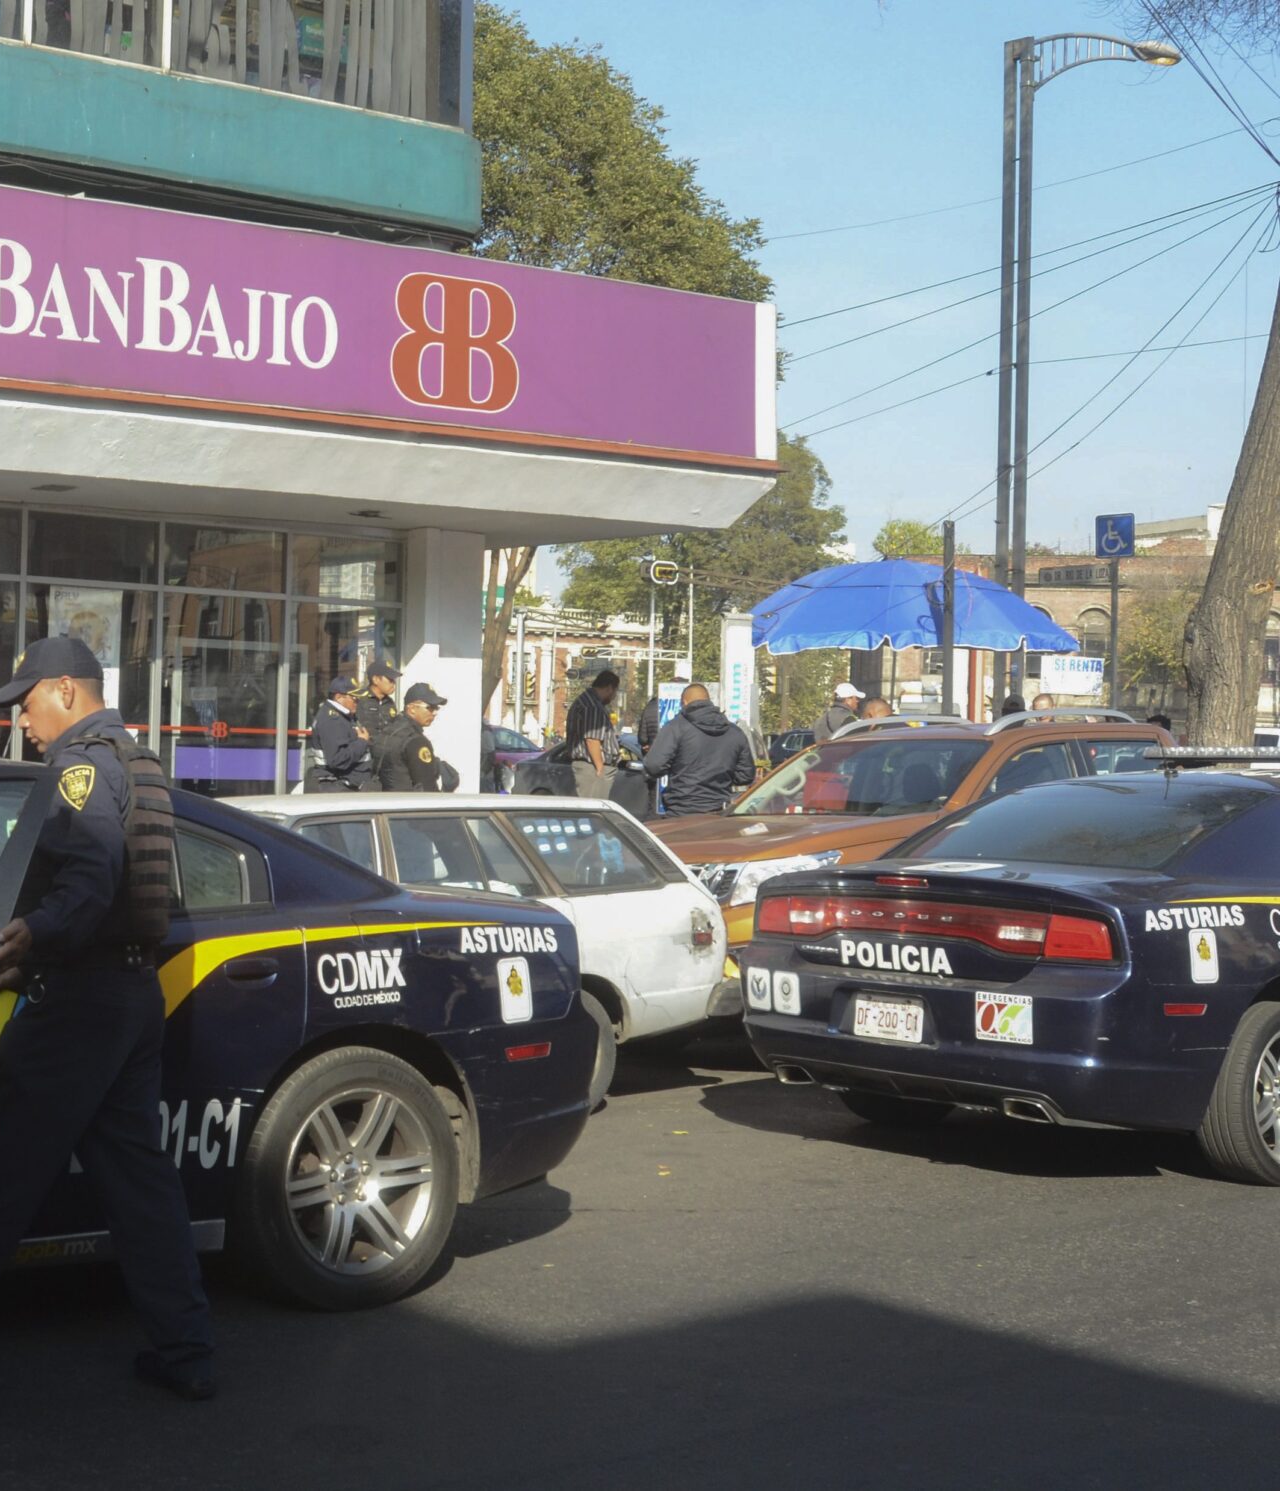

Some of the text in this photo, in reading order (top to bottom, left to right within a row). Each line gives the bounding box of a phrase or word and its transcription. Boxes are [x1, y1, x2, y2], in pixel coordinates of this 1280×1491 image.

[1055, 658, 1103, 672] SE RENTA
[1145, 904, 1246, 932] ASTURIAS
[460, 926, 559, 954] ASTURIAS
[840, 939, 954, 975] POLICIA
[317, 948, 407, 995] CDMX
[334, 990, 401, 1009] CIUDAD DE MÉXICO
[978, 993, 1032, 1006] EMERGENCIAS
